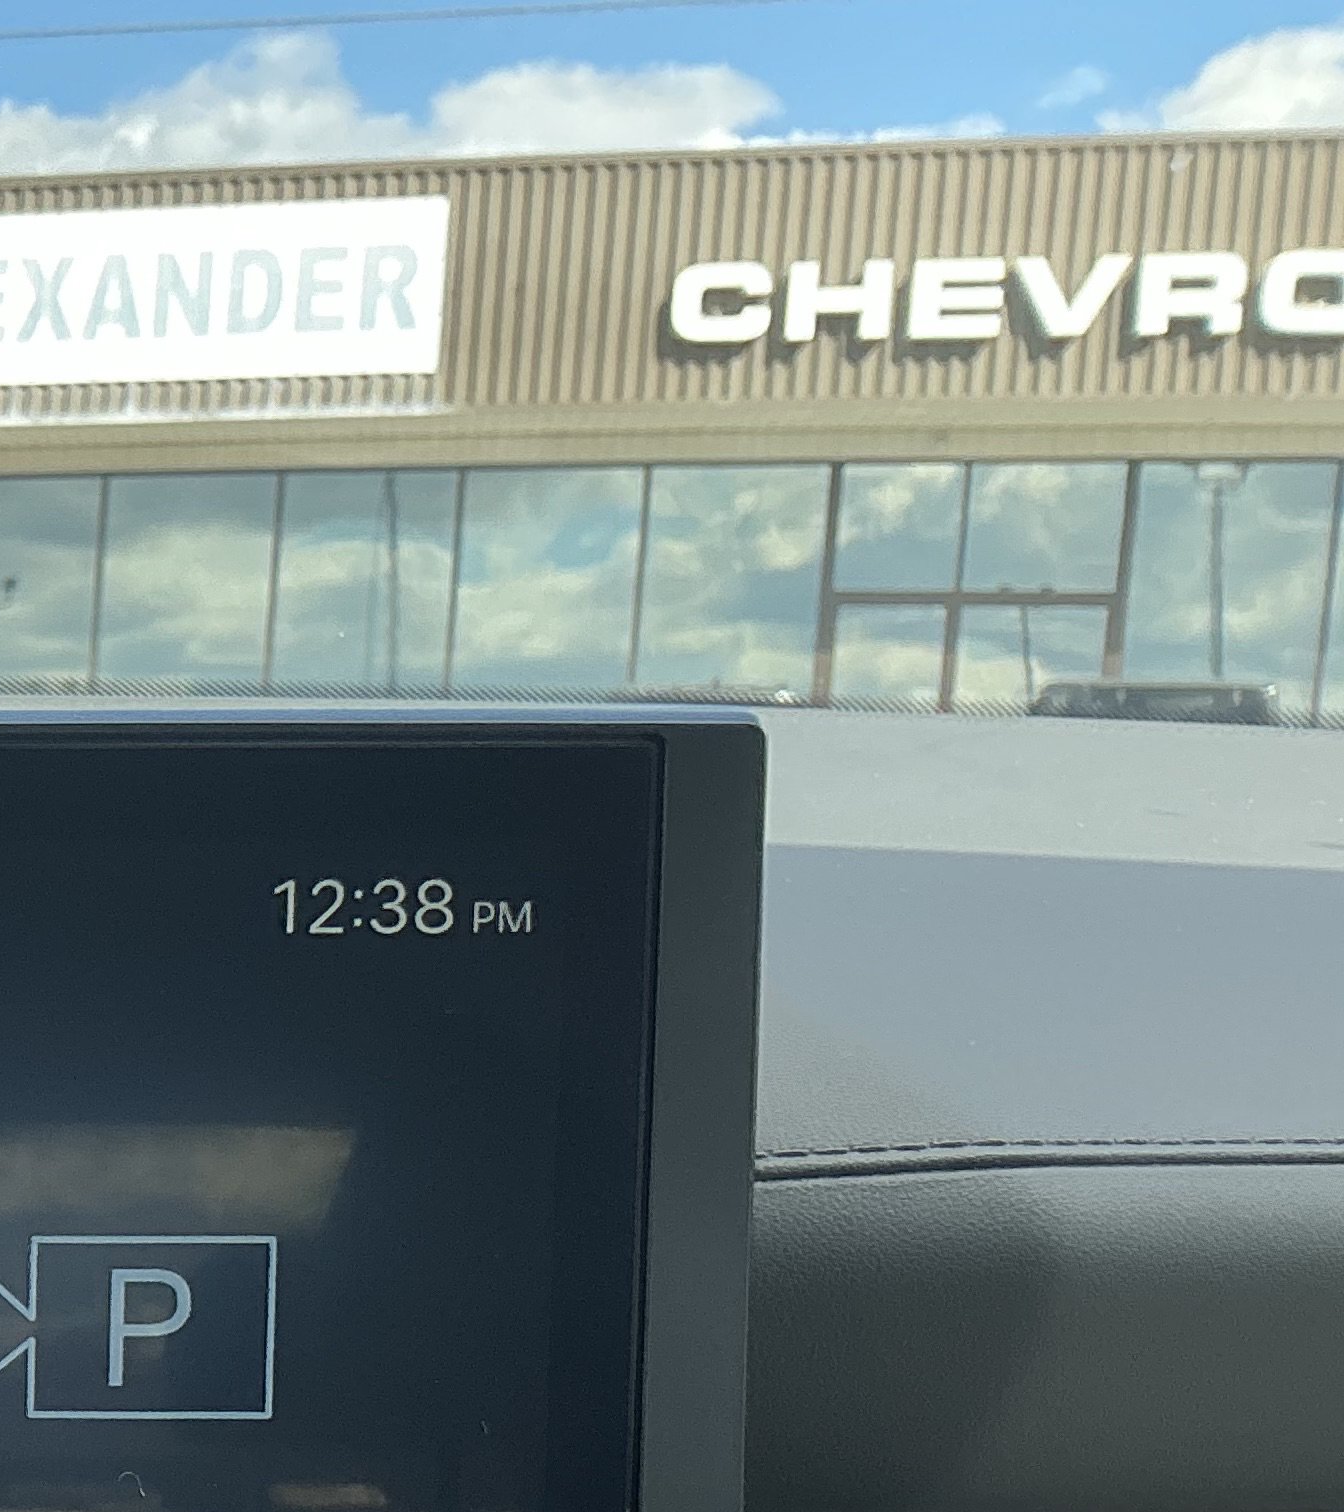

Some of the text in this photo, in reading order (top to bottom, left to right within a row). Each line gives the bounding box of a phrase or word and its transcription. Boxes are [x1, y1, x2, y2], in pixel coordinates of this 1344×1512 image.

[669, 246, 1344, 343] CHEVRO
[272, 878, 534, 935] 12:38 PM
[107, 1268, 193, 1387] P
